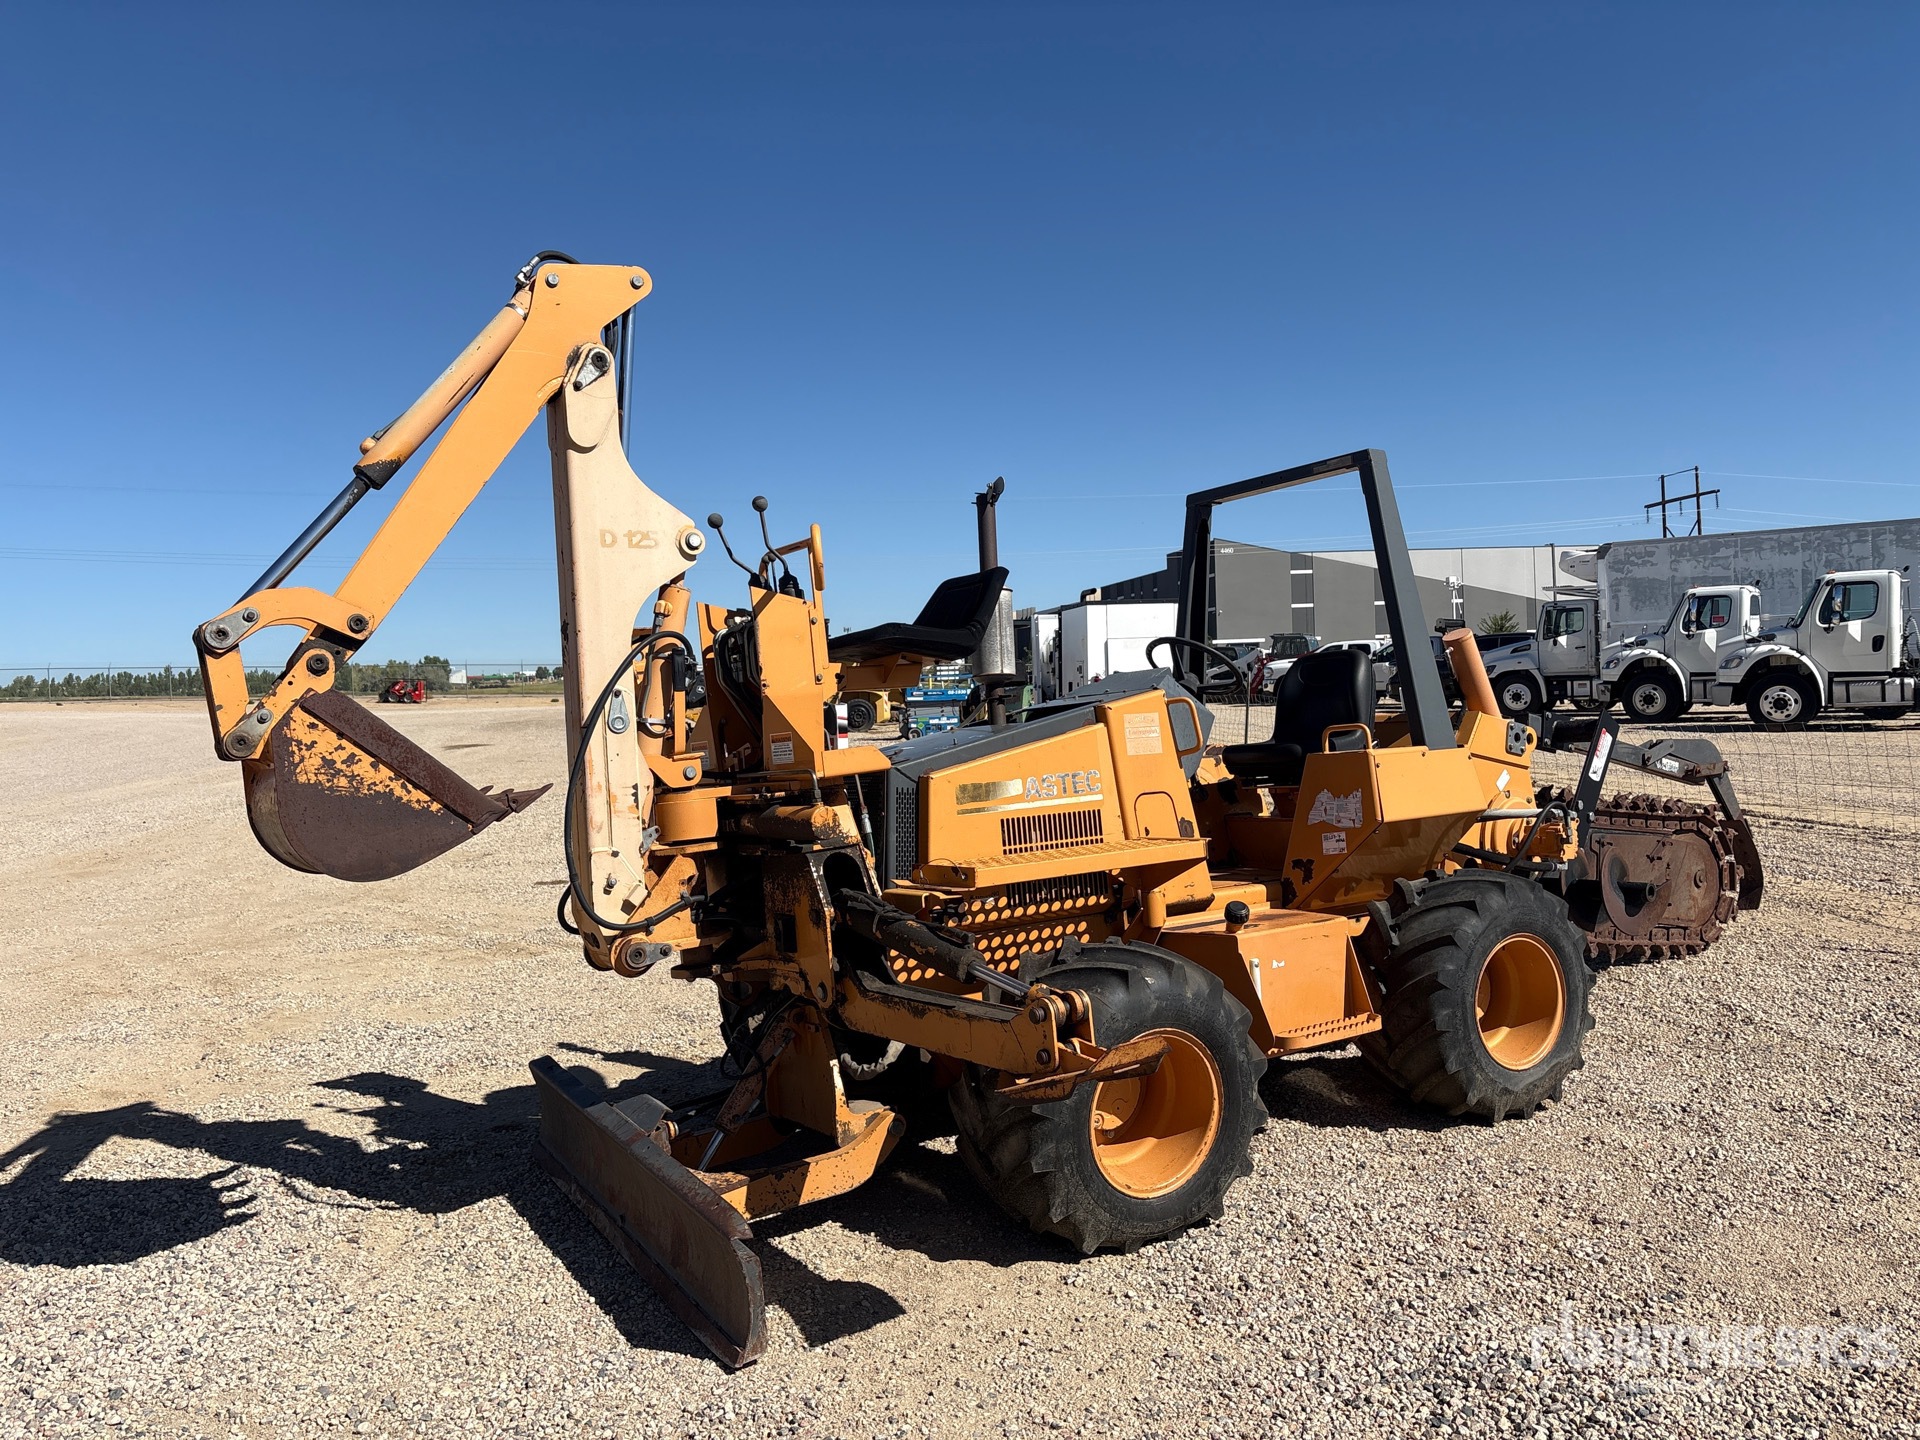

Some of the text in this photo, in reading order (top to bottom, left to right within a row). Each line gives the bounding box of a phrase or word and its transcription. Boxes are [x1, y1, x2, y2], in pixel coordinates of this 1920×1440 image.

[600, 529, 659, 549] D 125
[1025, 769, 1101, 800] ASTEC
